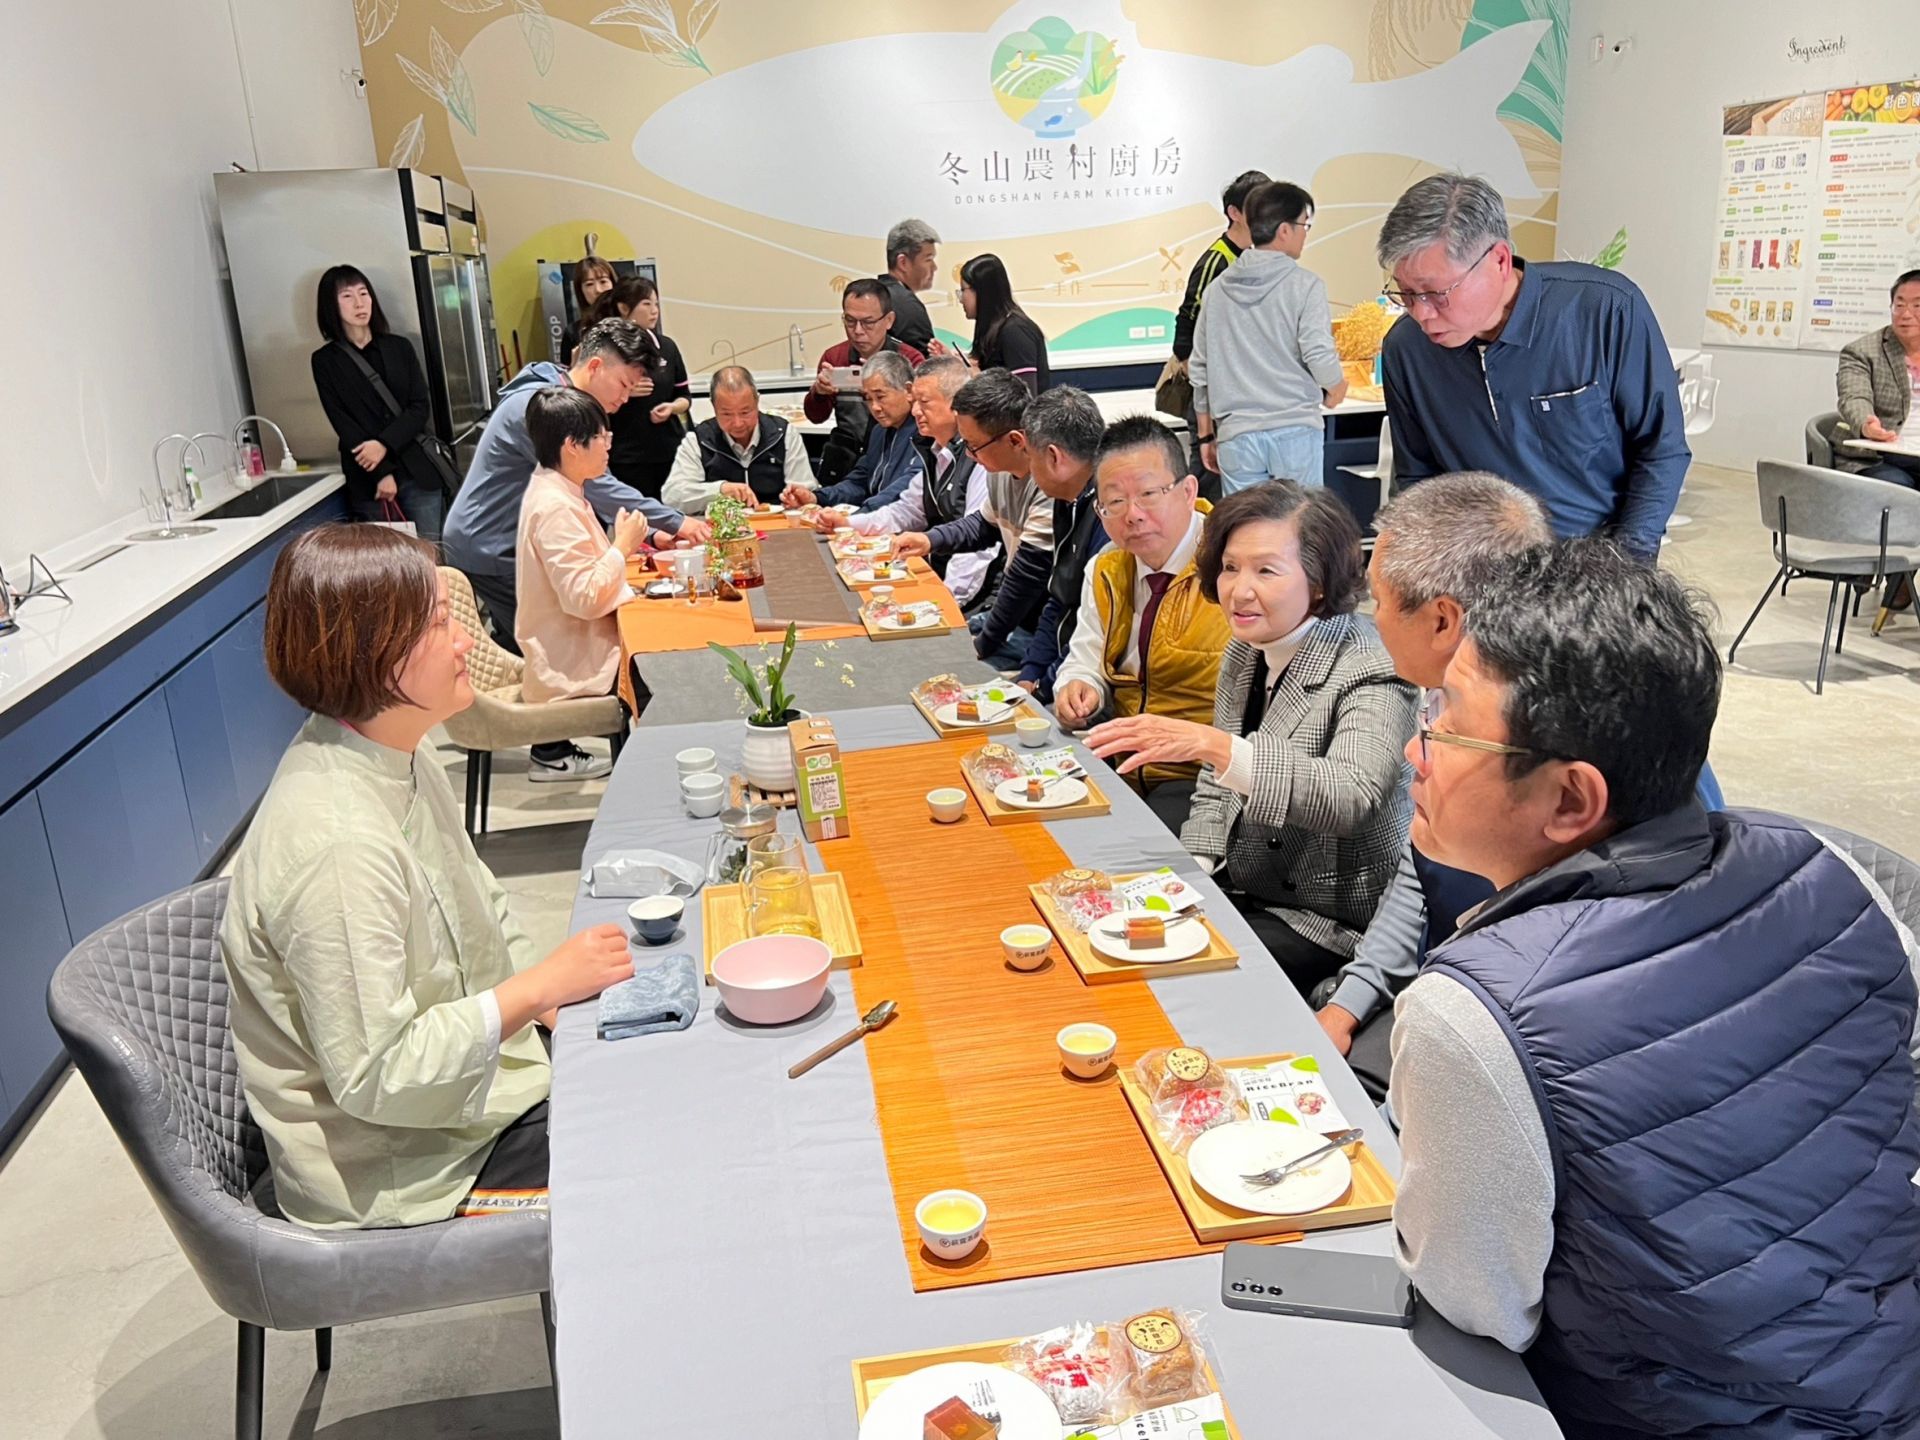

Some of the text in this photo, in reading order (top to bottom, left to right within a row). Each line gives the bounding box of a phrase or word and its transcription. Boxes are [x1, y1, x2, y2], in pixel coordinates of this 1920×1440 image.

[938, 137, 1182, 186] 冬山農村廚房
[954, 185, 1175, 205] DONGSHAN FARM KITCHEN
